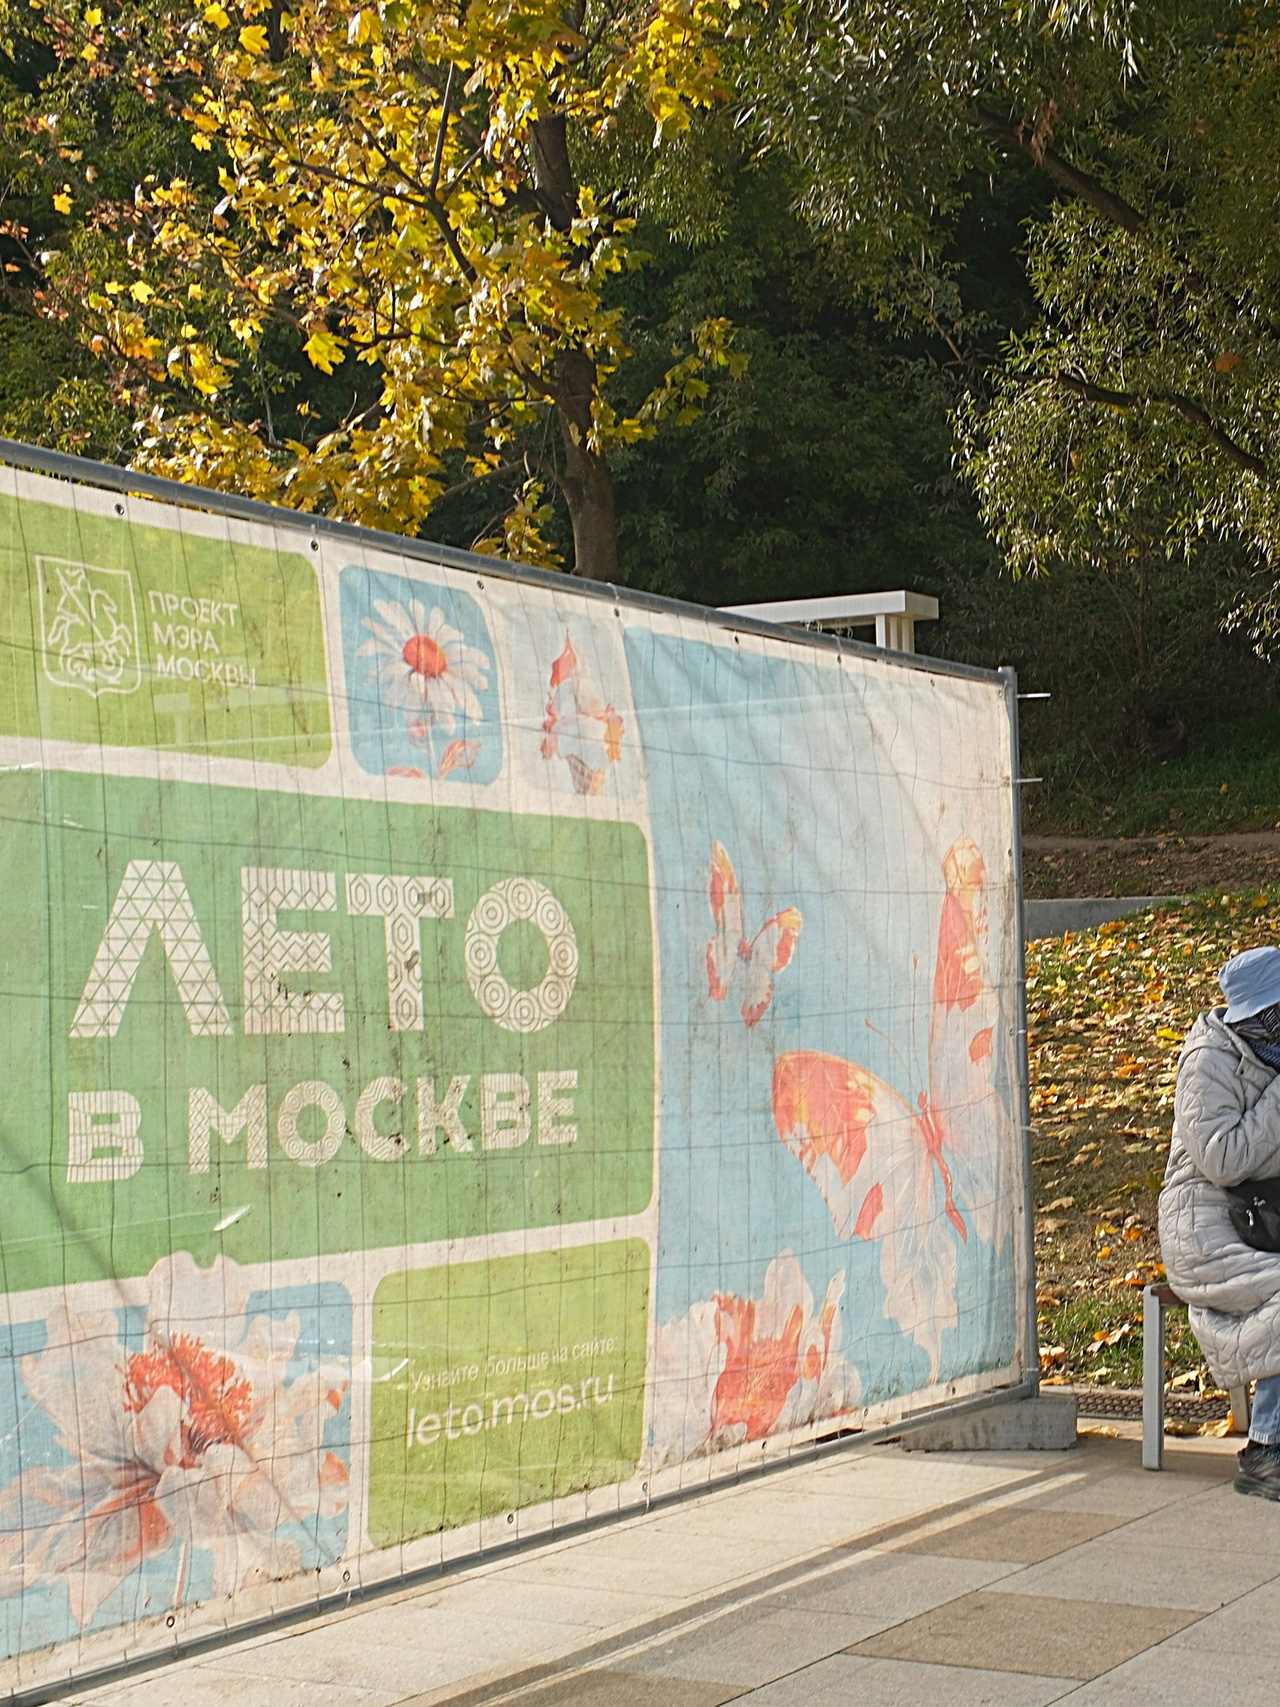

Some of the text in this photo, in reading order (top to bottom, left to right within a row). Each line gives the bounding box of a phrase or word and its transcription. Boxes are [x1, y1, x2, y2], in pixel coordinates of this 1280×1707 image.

[149, 591, 237, 626] ПРОЕКТ
[153, 622, 219, 653] МЭРА
[156, 654, 256, 690] МОСКВЫ
[69, 859, 579, 1038] ЛЕТО
[67, 1069, 578, 1184] В МОСКВЕ
[410, 1364, 479, 1393] Узнайте
[487, 1353, 550, 1377] больше
[551, 1348, 568, 1363] на
[405, 1373, 615, 1448] leto.mos.ru
